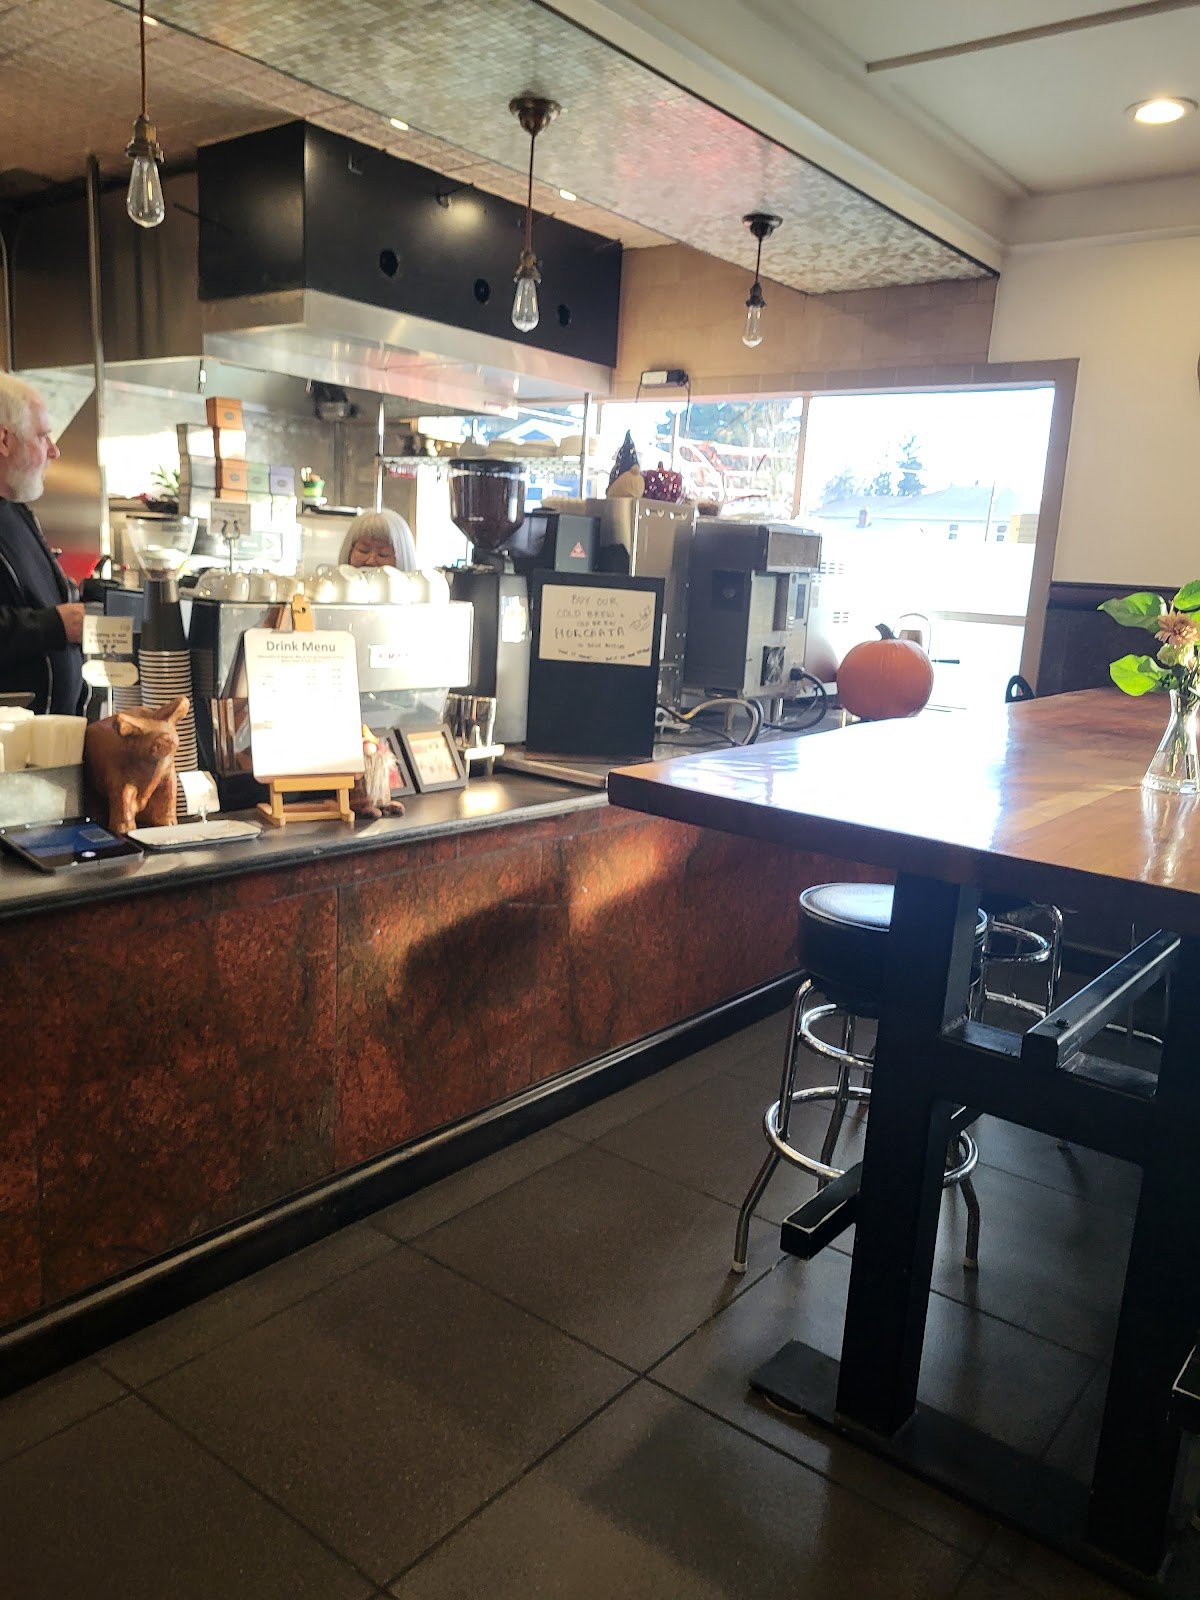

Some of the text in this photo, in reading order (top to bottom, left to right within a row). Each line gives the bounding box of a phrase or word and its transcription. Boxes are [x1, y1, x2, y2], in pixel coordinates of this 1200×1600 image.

[571, 593, 618, 607] BUY OUR
[556, 608, 581, 618] COLD
[587, 610, 615, 618] BREW
[554, 626, 625, 639] HORCHATA
[266, 640, 336, 652] Drink Menu
